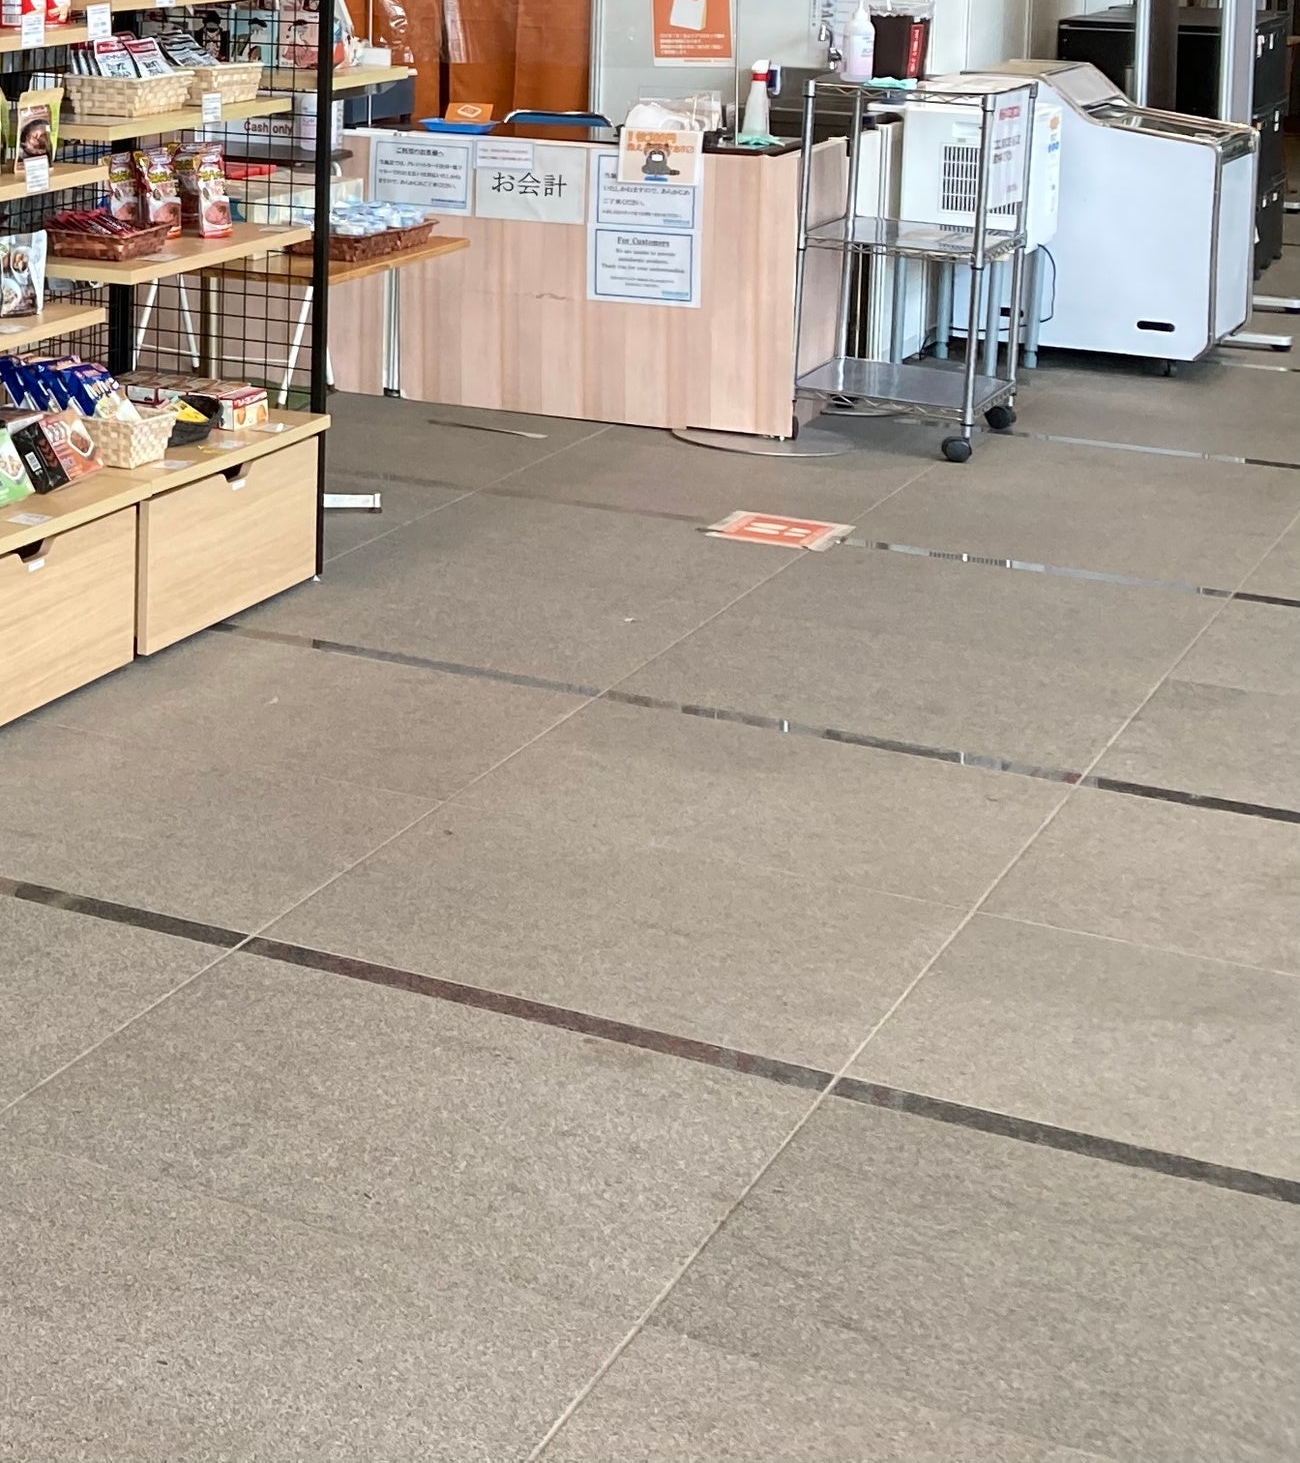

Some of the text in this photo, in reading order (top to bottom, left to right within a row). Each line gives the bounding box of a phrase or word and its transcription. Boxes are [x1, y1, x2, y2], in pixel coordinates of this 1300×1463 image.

[243, 120, 294, 137] Cash only
[491, 171, 568, 198] お会計
